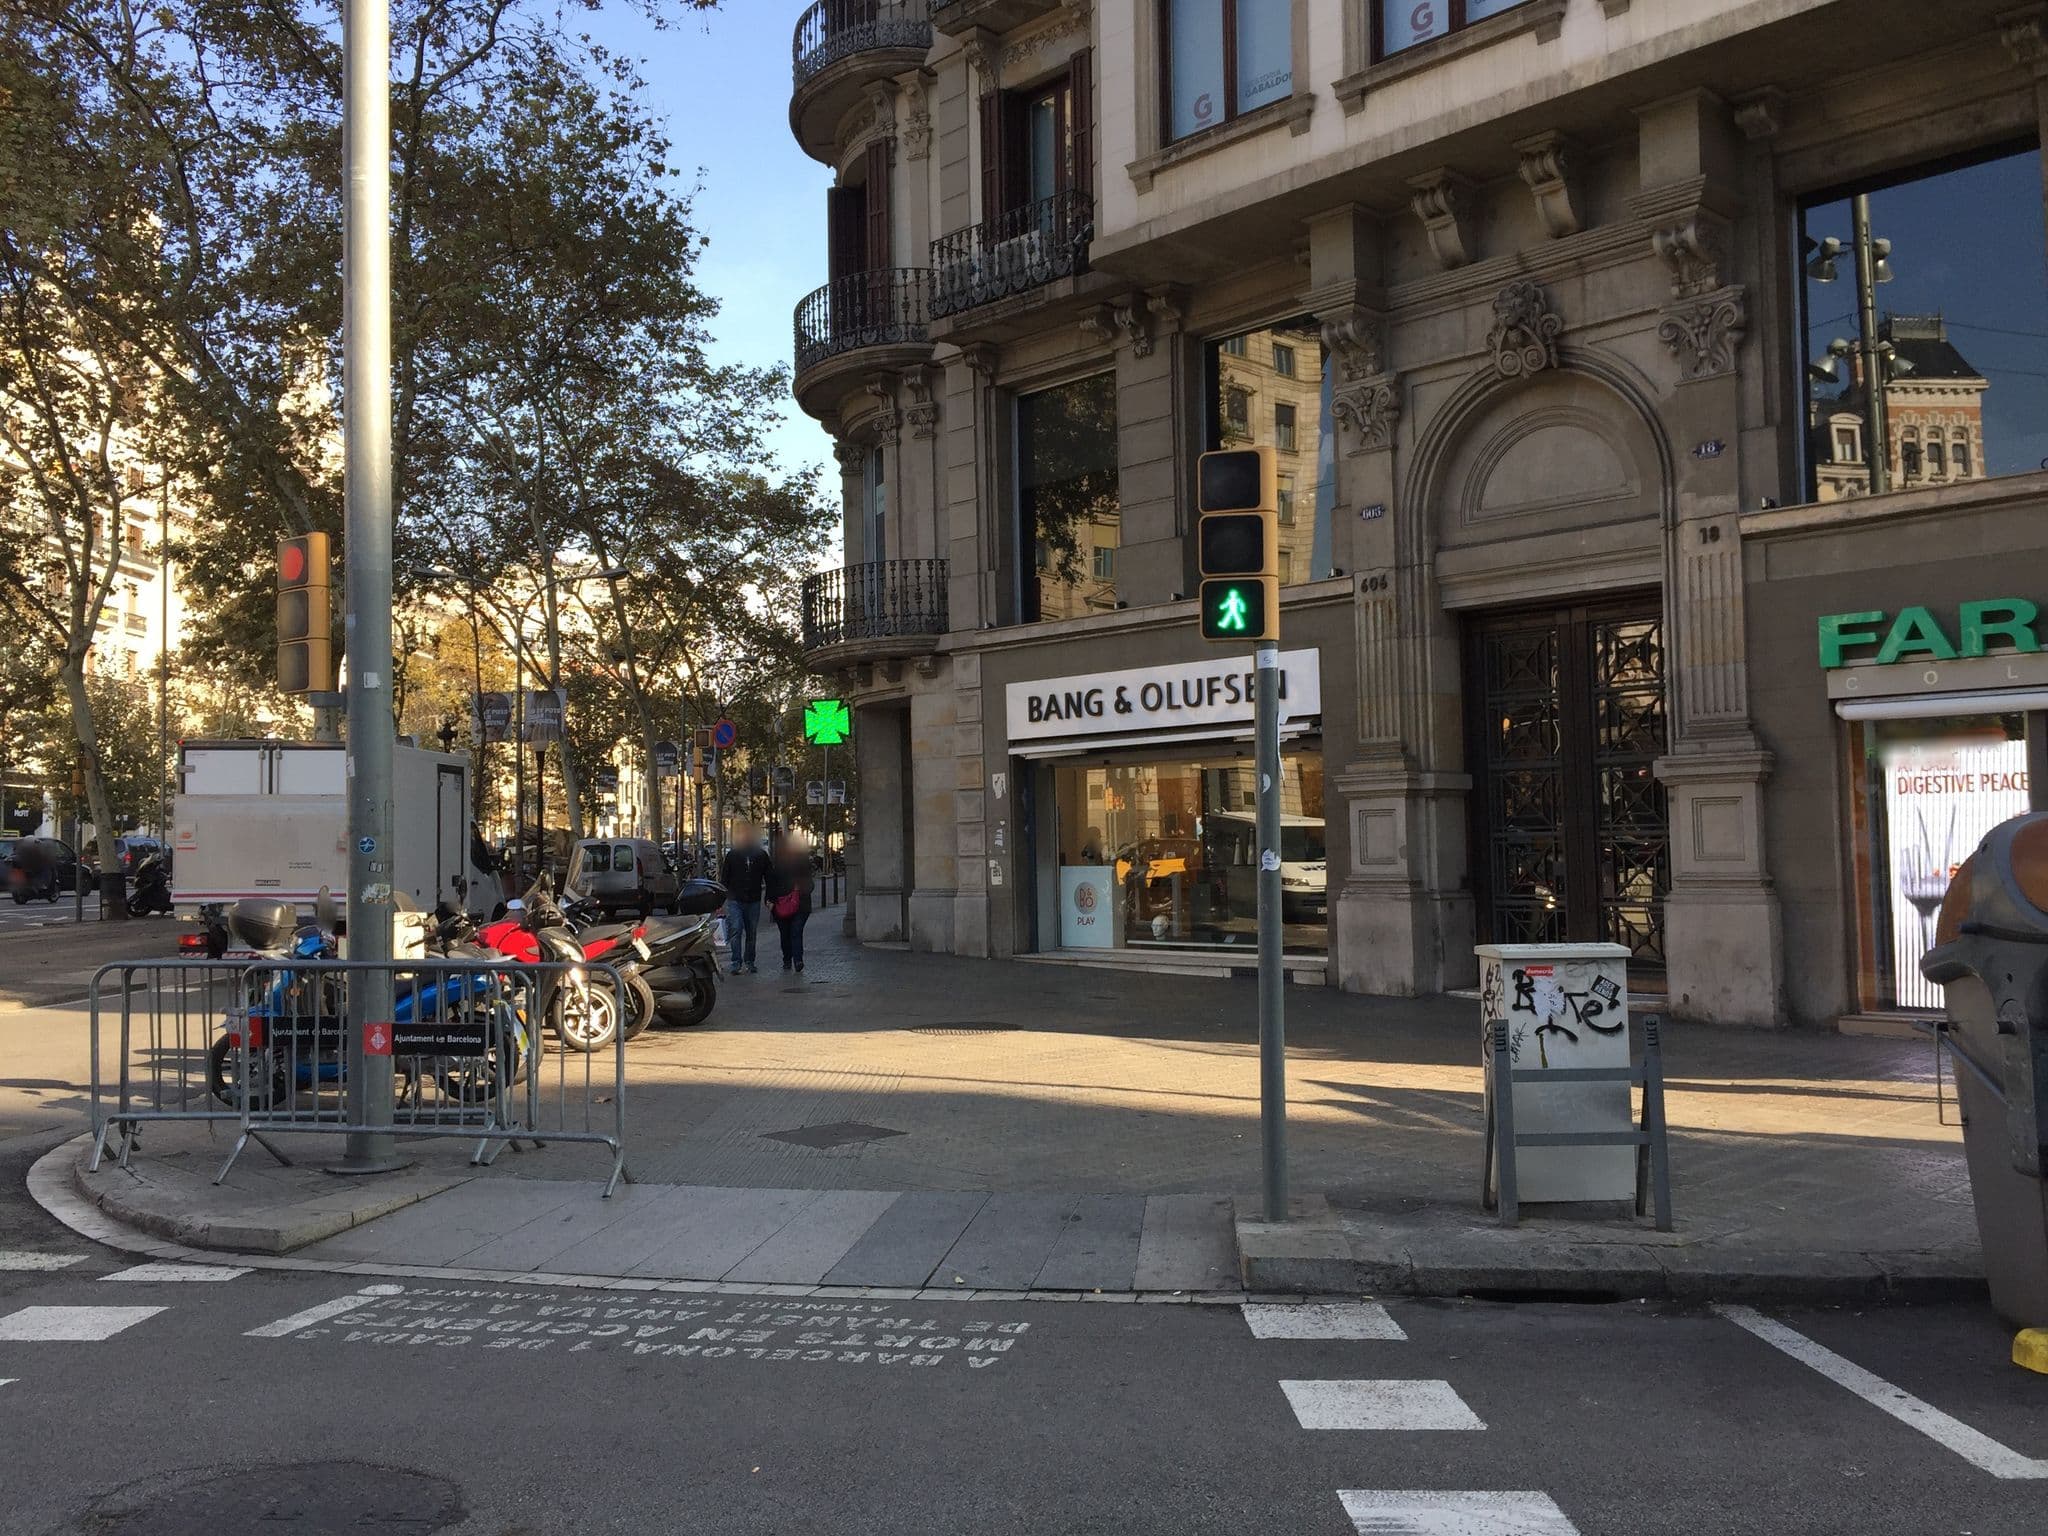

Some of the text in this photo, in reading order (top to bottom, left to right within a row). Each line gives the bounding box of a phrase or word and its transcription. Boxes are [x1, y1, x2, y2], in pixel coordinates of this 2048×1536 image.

[1411, 2, 1434, 31] G
[1194, 93, 1212, 120] G
[1701, 441, 1716, 454] 18
[1361, 574, 1388, 593] 606
[1028, 688, 1103, 723] BANG
[1114, 685, 1132, 714] &
[1897, 772, 2030, 795] DIGESTIVE PEACE
[1077, 916, 1095, 926] PLAY
[394, 1034, 434, 1043] Ajuntament
[447, 1035, 482, 1043] Barcelona
[1494, 1026, 1507, 1052] LUCE
[488, 1304, 521, 1314] A
[536, 1305, 708, 1321] ANAVA
[333, 1312, 1015, 1351] MORTS EN ACCIDENTS
[962, 1321, 1031, 1334] DE
[344, 1331, 472, 1346] CADA
[481, 1337, 556, 1350] DE
[968, 1356, 999, 1369] A
